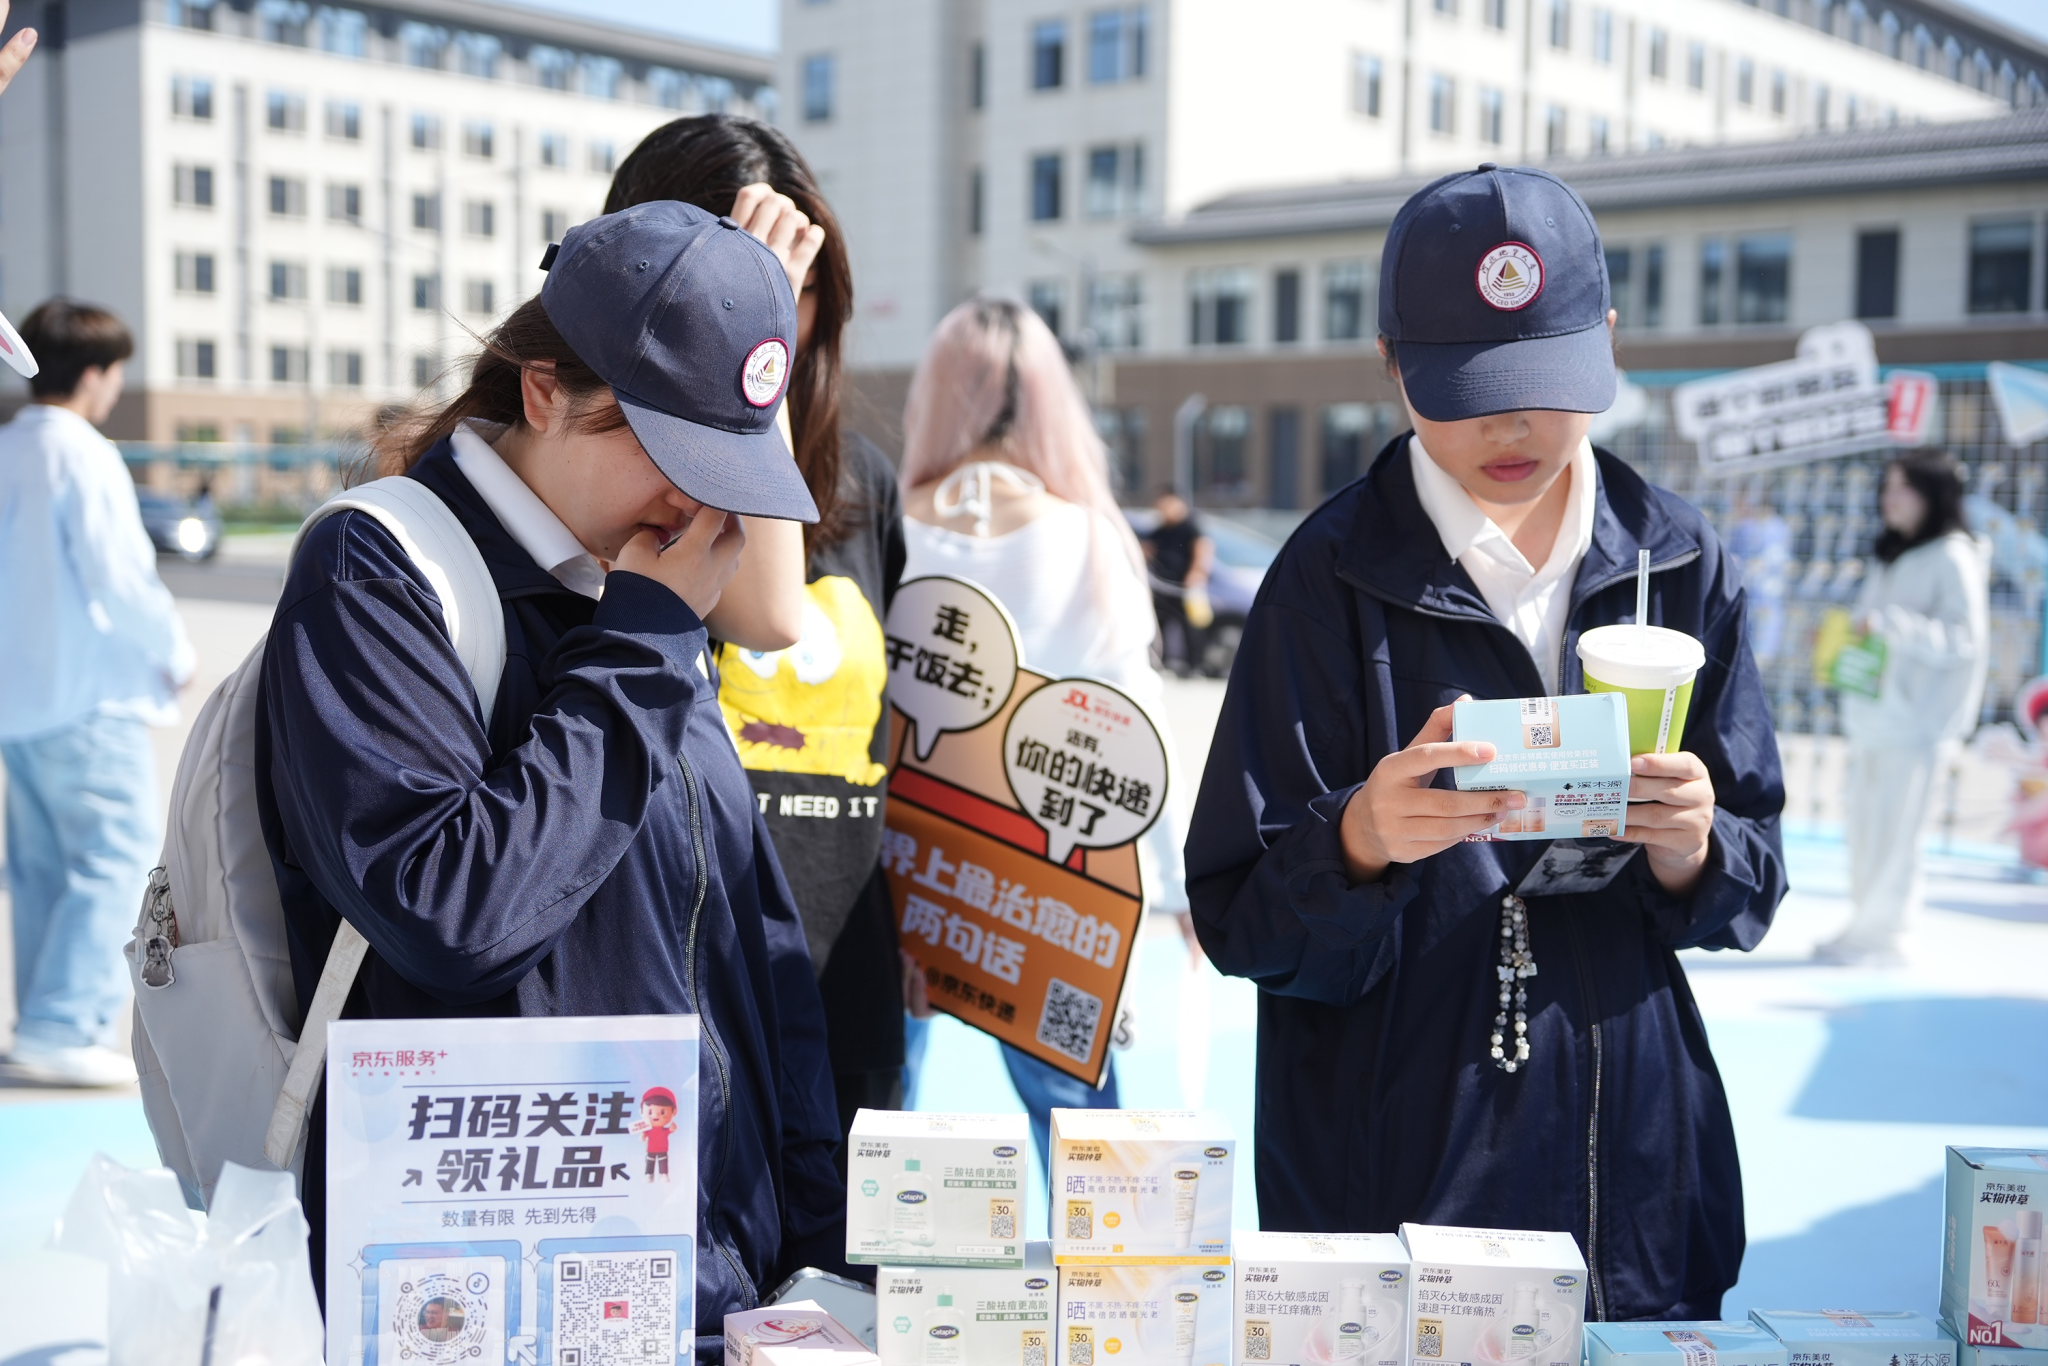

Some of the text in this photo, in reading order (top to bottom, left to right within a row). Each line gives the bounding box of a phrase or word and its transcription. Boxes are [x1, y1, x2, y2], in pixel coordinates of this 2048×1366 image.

[1493, 749, 1598, 763] 名京东采销真实使用效果视频
[1489, 759, 1599, 774] 扫码领优惠券 便宜买正装
[1015, 736, 1153, 818] 你的快递
[779, 794, 840, 819] NEED
[848, 796, 879, 818] IT
[1039, 787, 1106, 837] 到了
[901, 893, 1027, 986] 两句话
[407, 1091, 635, 1141] 扫码关注
[436, 1146, 606, 1193] 领礼品
[944, 1167, 1017, 1179] 三酸祛痘更高阶
[1066, 1175, 1086, 1195] 晒
[1986, 1183, 2026, 1192] 京东美妆
[899, 1192, 924, 1203] Cetaphil
[996, 1205, 1009, 1215] 30
[1074, 1207, 1087, 1217] 30
[441, 1206, 598, 1228] 数量有限 先到先得
[1245, 1290, 1329, 1303] 掐灭6大敏感成因
[1418, 1289, 1503, 1305] 掐灭6大敏感成因
[976, 1300, 1048, 1311] 三酸祛痘更高阶
[1067, 1301, 1086, 1321] 晒
[1244, 1303, 1322, 1316] 速退干红痒痛热
[1417, 1302, 1496, 1318] 速退干红痒痛热
[931, 1327, 957, 1338] Cetaphil
[1251, 1327, 1265, 1336] 30
[1423, 1325, 1437, 1335] 30
[1970, 1320, 2003, 1344] NO.1
[1028, 1337, 1041, 1347] 30
[1074, 1333, 1088, 1343] 30
[1793, 1353, 1831, 1361] 京东美妆
[1904, 1353, 1950, 1366] 溪木源
